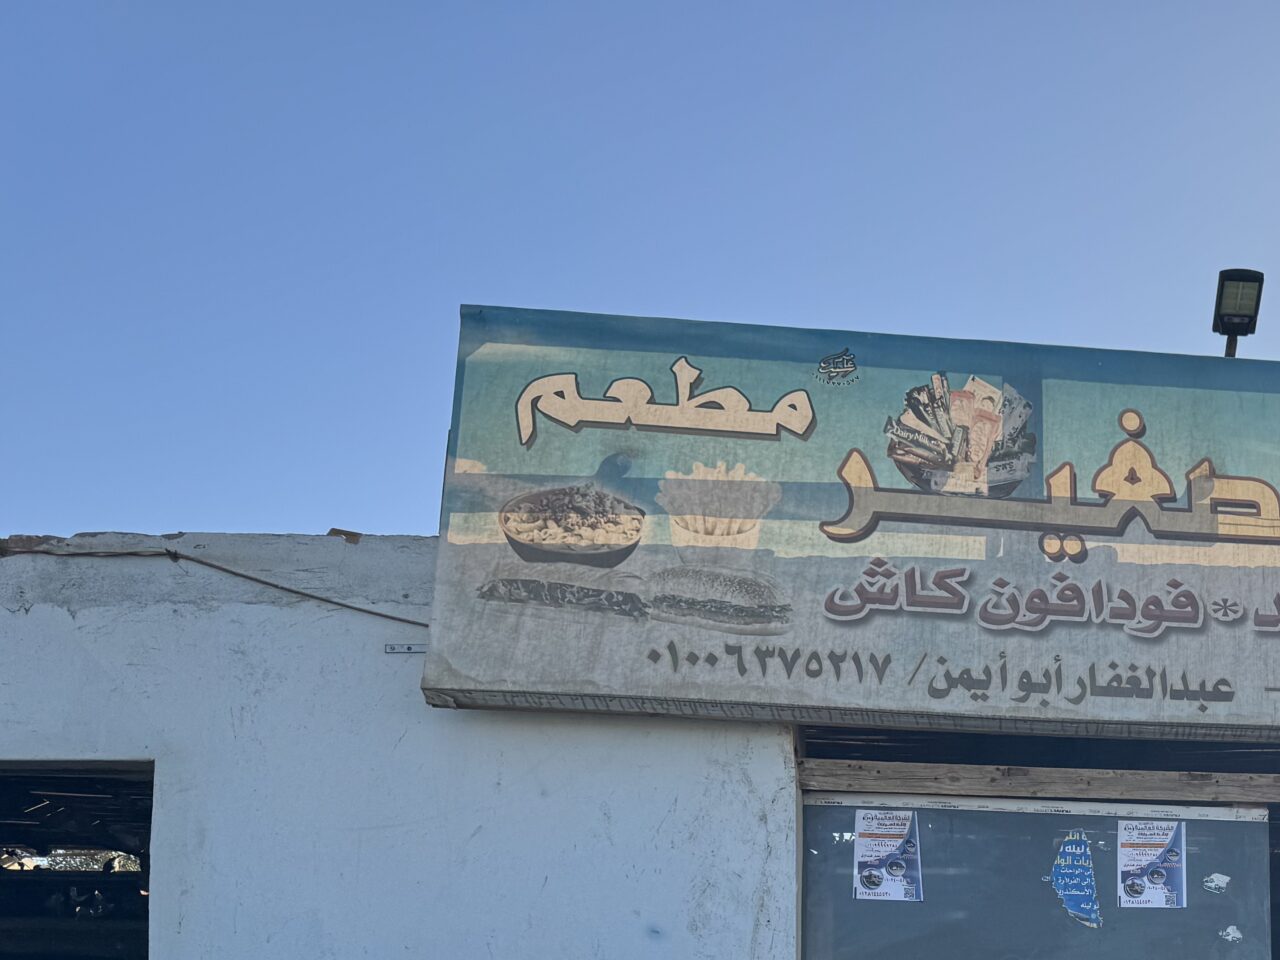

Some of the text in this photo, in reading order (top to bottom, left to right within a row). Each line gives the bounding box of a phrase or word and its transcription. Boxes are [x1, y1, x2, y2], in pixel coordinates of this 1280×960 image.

[515, 356, 816, 447] مطعم
[824, 556, 968, 619] كاش
[978, 571, 1202, 635] فودافون
